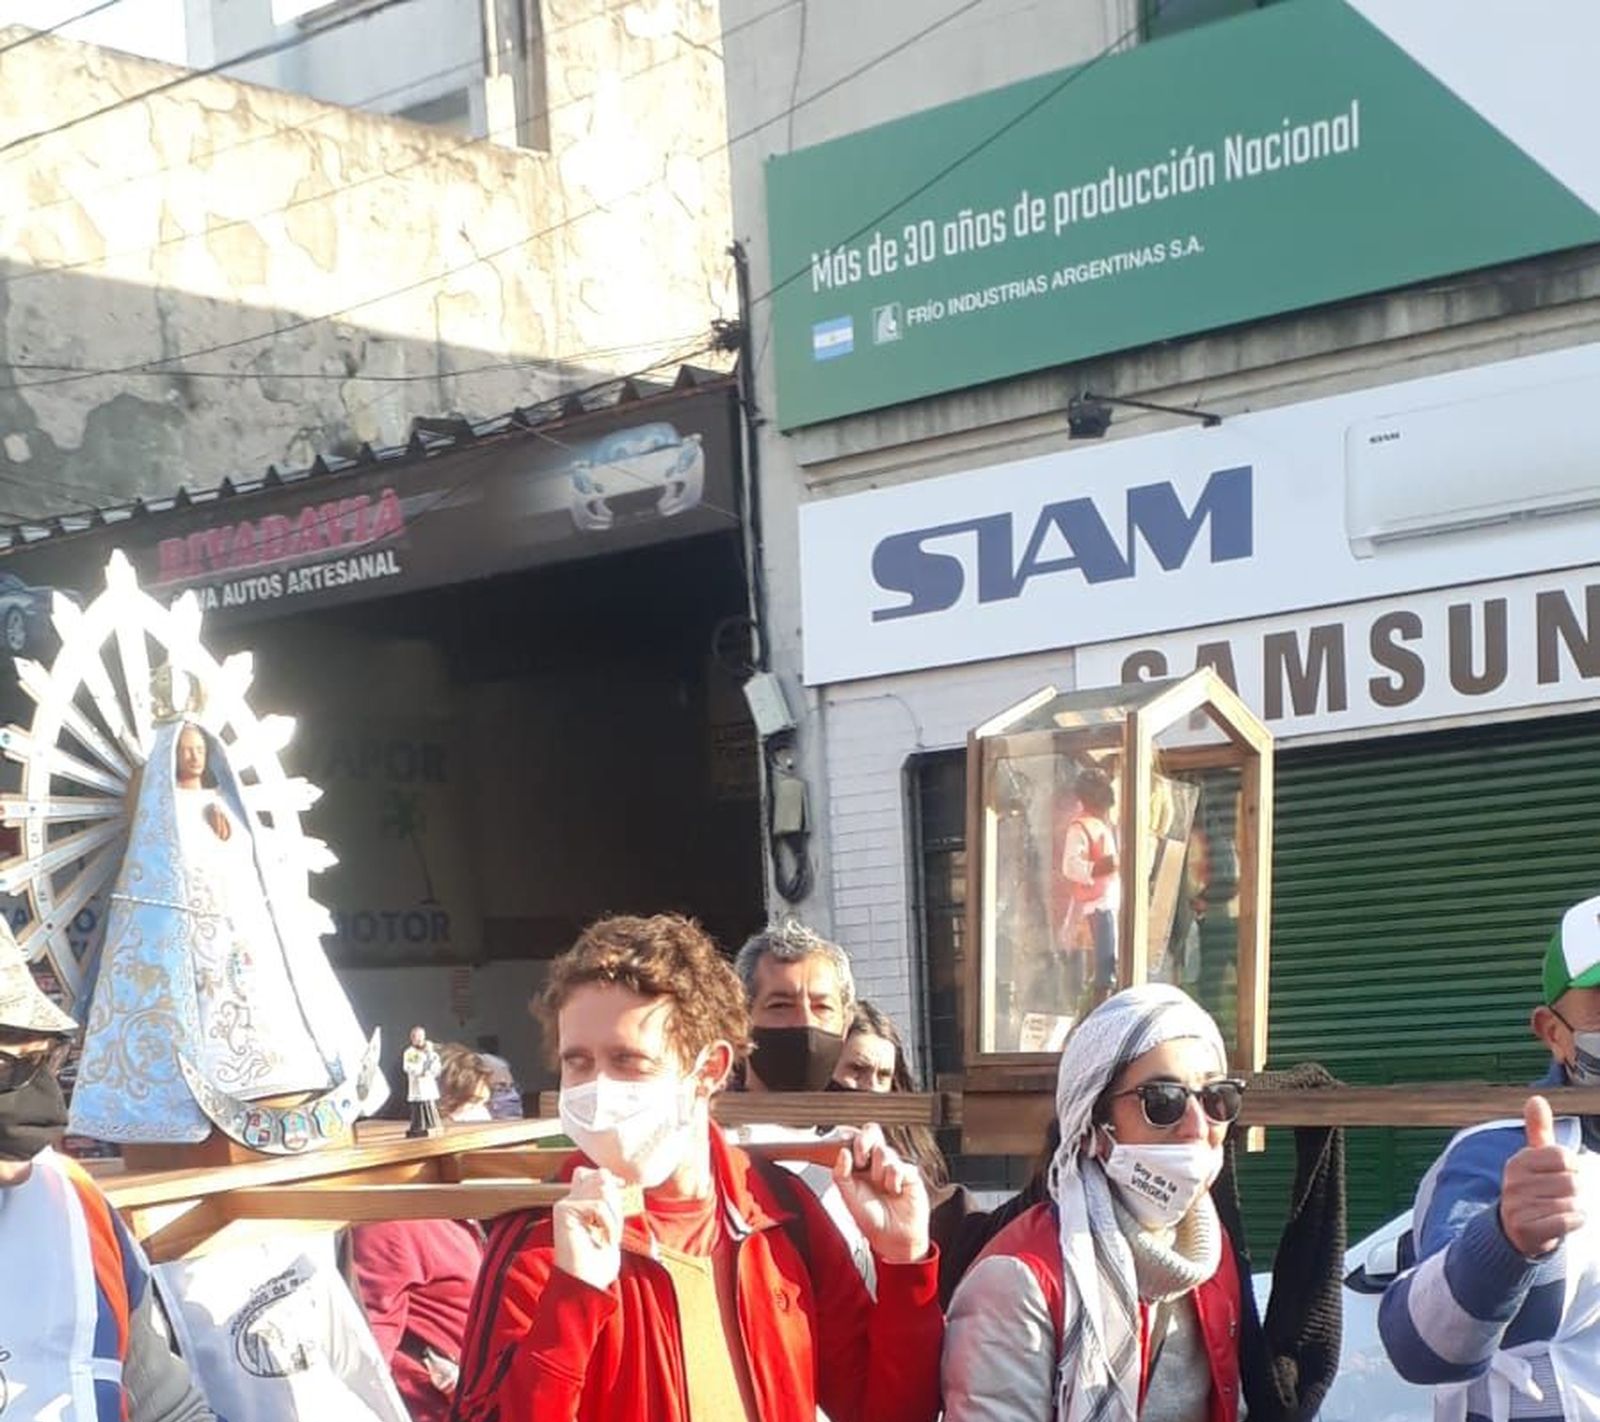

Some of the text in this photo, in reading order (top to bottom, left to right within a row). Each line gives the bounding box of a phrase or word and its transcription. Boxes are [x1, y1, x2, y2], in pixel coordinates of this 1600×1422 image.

[811, 99, 1359, 293] Más de 30 años de producción Nacional
[906, 235, 1205, 328] FRÍO INDUSTRIAS ARGENTINAS S.A.
[222, 574, 283, 607] AUTOS
[286, 550, 401, 595] ARTESANAL
[871, 465, 1253, 623] SIAM
[1131, 1177, 1169, 1203] VIRGEN
